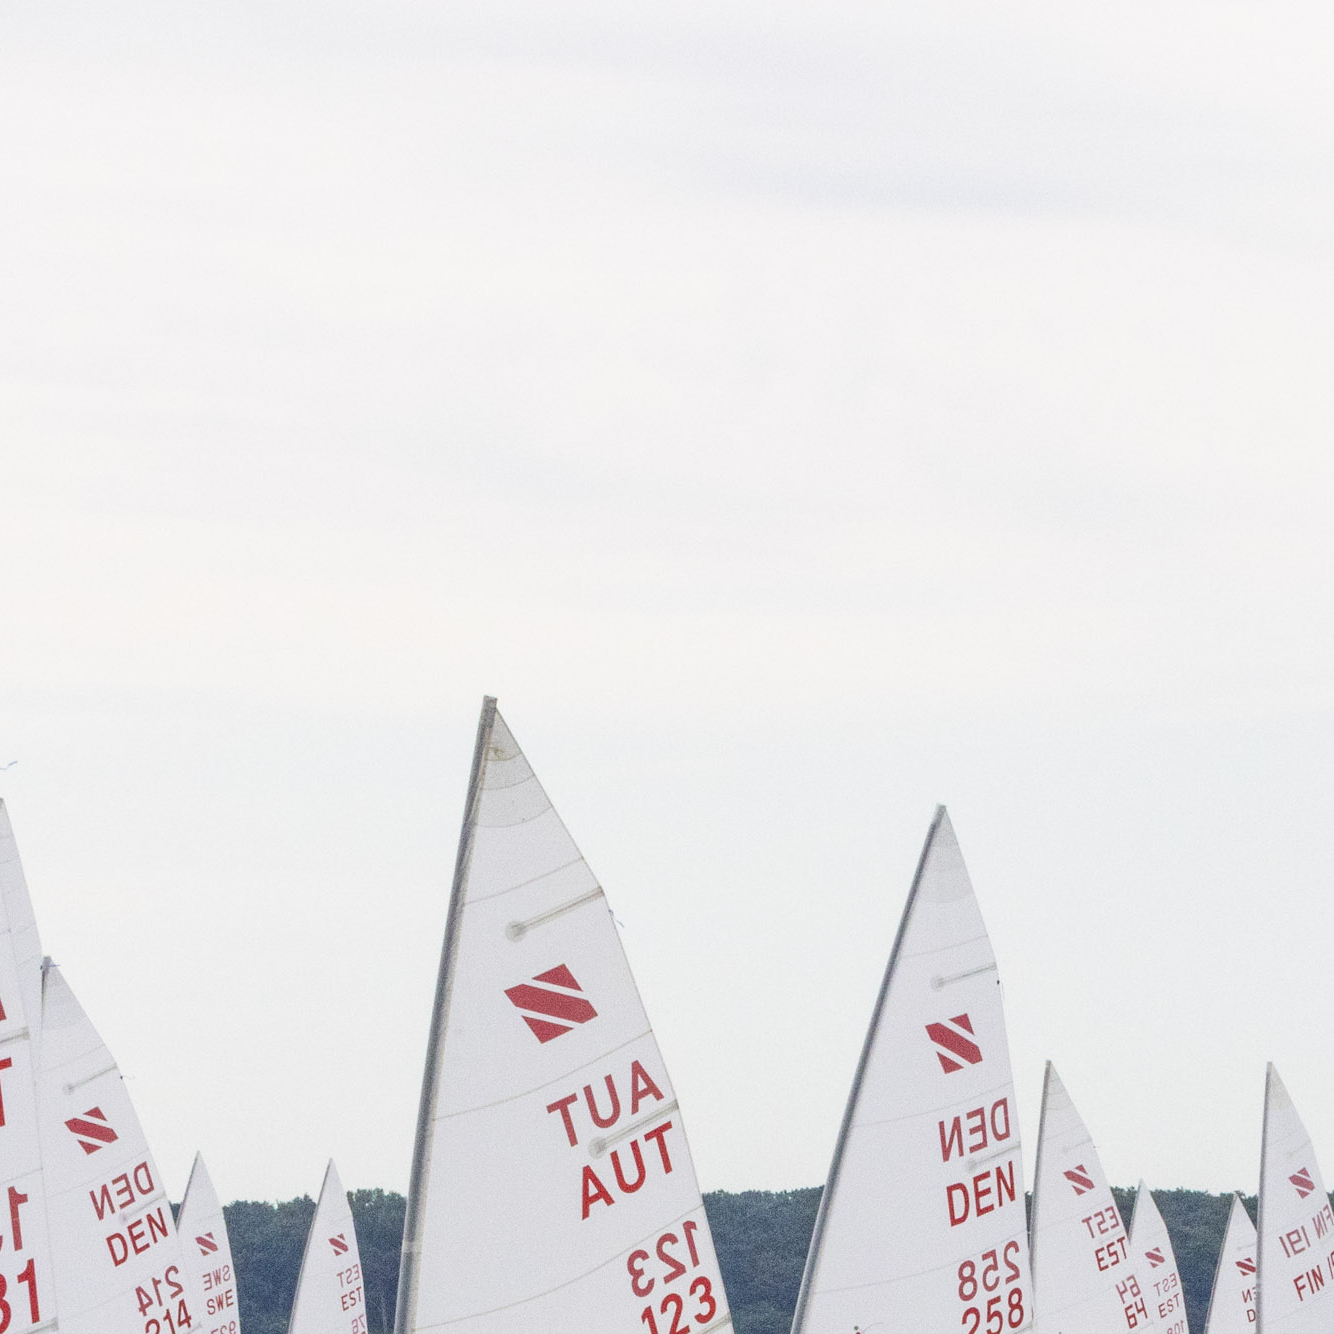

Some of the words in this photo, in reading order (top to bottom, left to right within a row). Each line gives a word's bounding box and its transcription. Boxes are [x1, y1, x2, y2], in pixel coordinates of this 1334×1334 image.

[582, 1120, 673, 1220] AUT
[946, 1161, 1016, 1227] DEN
[106, 1207, 169, 1267] DEN
[1095, 1236, 1127, 1271] EST
[341, 1286, 362, 1311] EST
[1293, 1264, 1324, 1302] FIN
[207, 1289, 234, 1315] SWE
[1124, 1298, 1148, 1329] 64
[1158, 1293, 1180, 1318] EST
